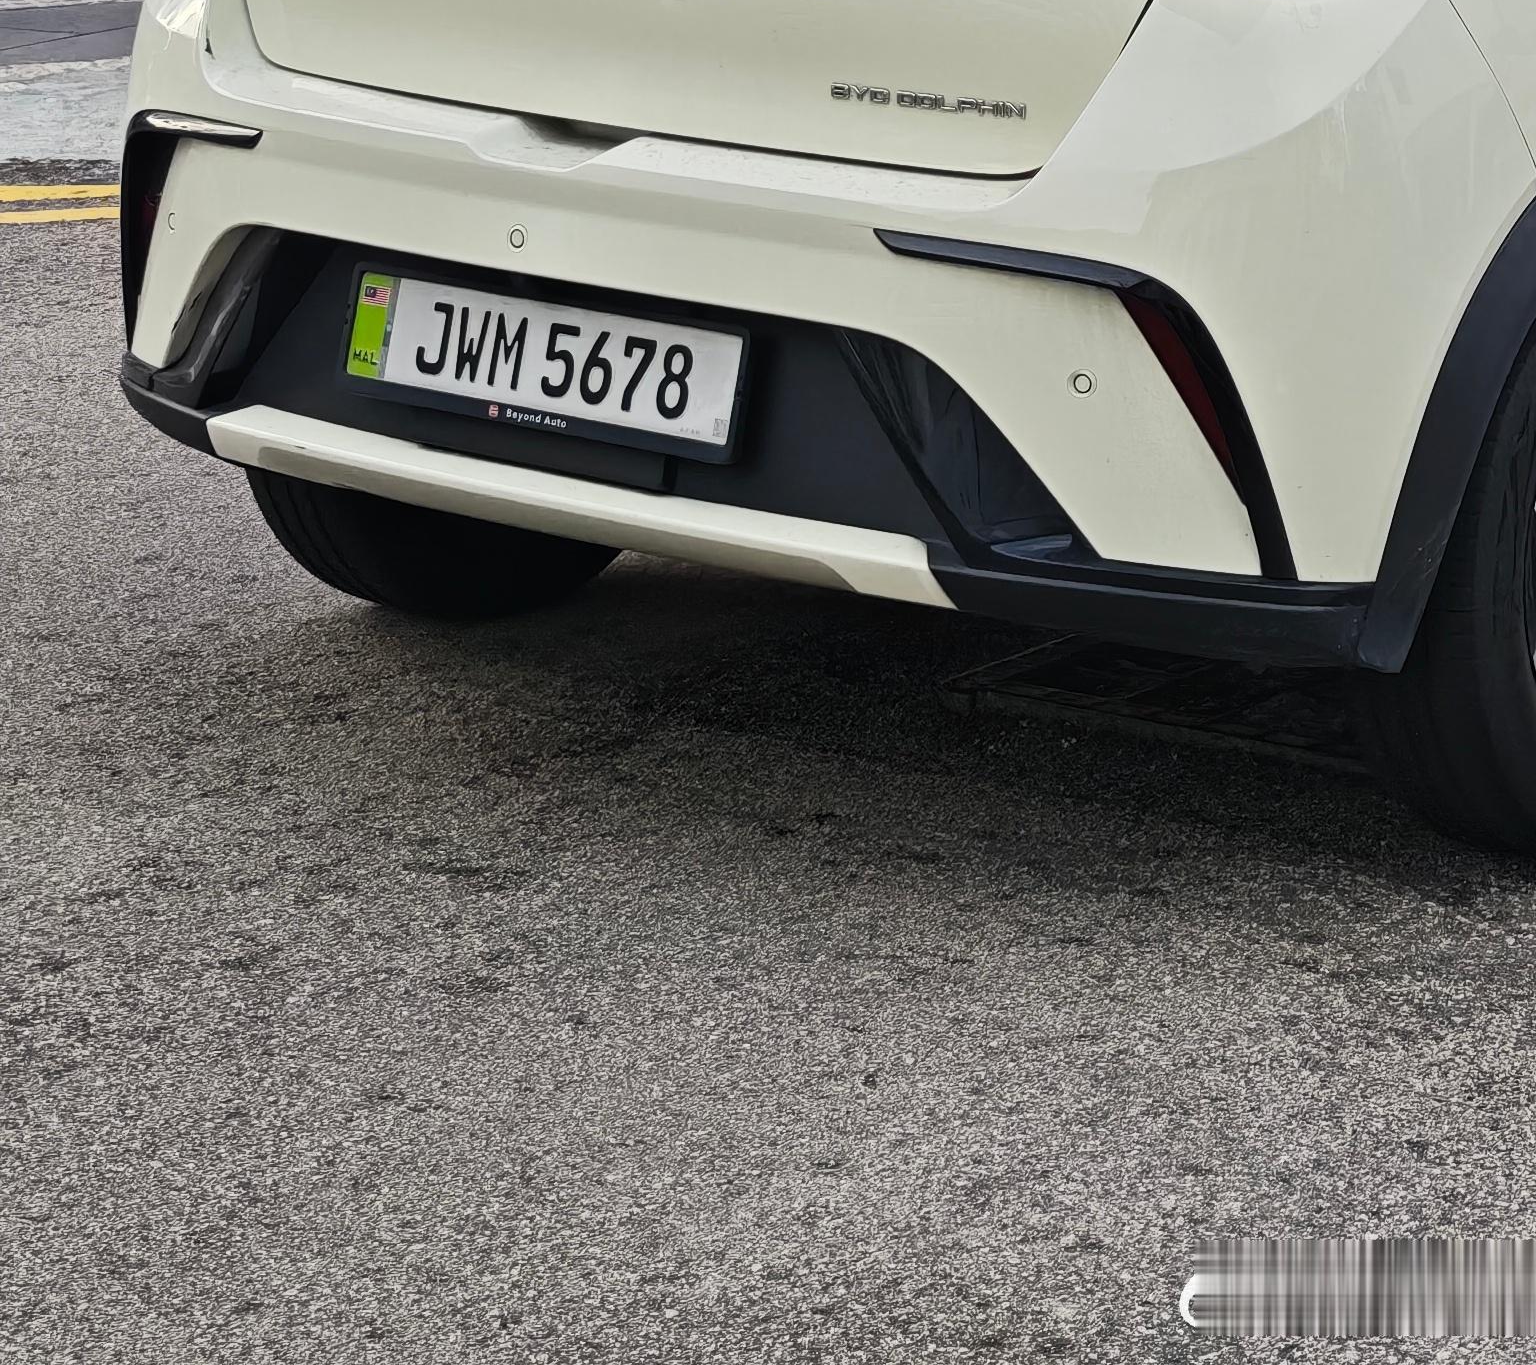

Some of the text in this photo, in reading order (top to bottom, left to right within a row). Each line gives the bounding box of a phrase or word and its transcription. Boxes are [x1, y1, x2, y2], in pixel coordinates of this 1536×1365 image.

[830, 82, 1026, 120] BYD DOLPHIN
[353, 348, 378, 366] MAL
[415, 301, 694, 419] JWM 5678
[506, 408, 567, 428] Beyond Auto
